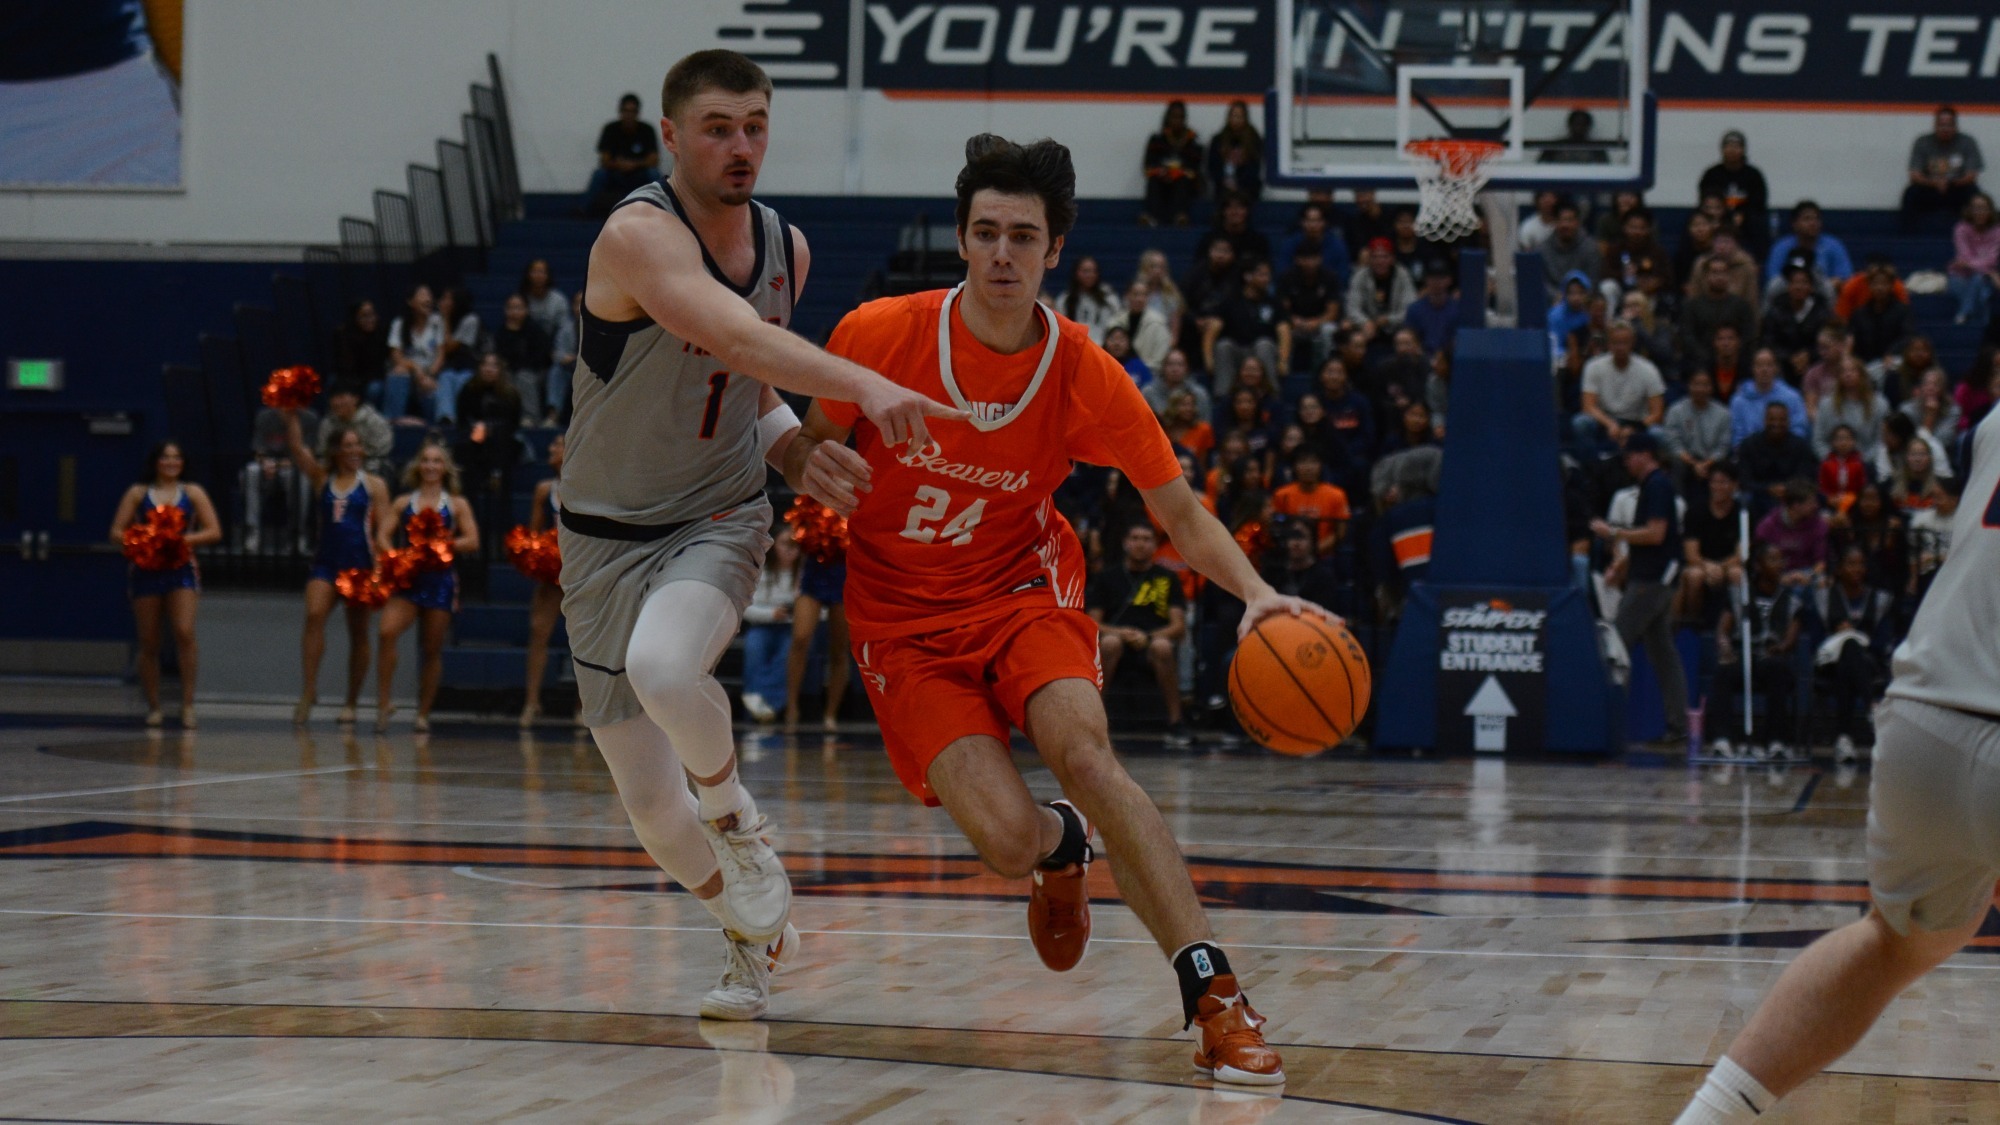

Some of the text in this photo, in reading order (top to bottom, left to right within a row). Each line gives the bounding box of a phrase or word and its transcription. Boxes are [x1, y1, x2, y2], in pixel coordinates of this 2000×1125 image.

[866, 4, 1258, 69] YOU'RE
[1293, 9, 1404, 70] IN
[1438, 10, 1811, 76] TITANS
[699, 371, 730, 439] 1
[896, 438, 1030, 493] Beavers
[898, 484, 989, 547] 24
[1441, 602, 1548, 630] STAMPEDE
[1447, 632, 1538, 653] STUDENT
[1440, 652, 1544, 673] ENTRANCE
